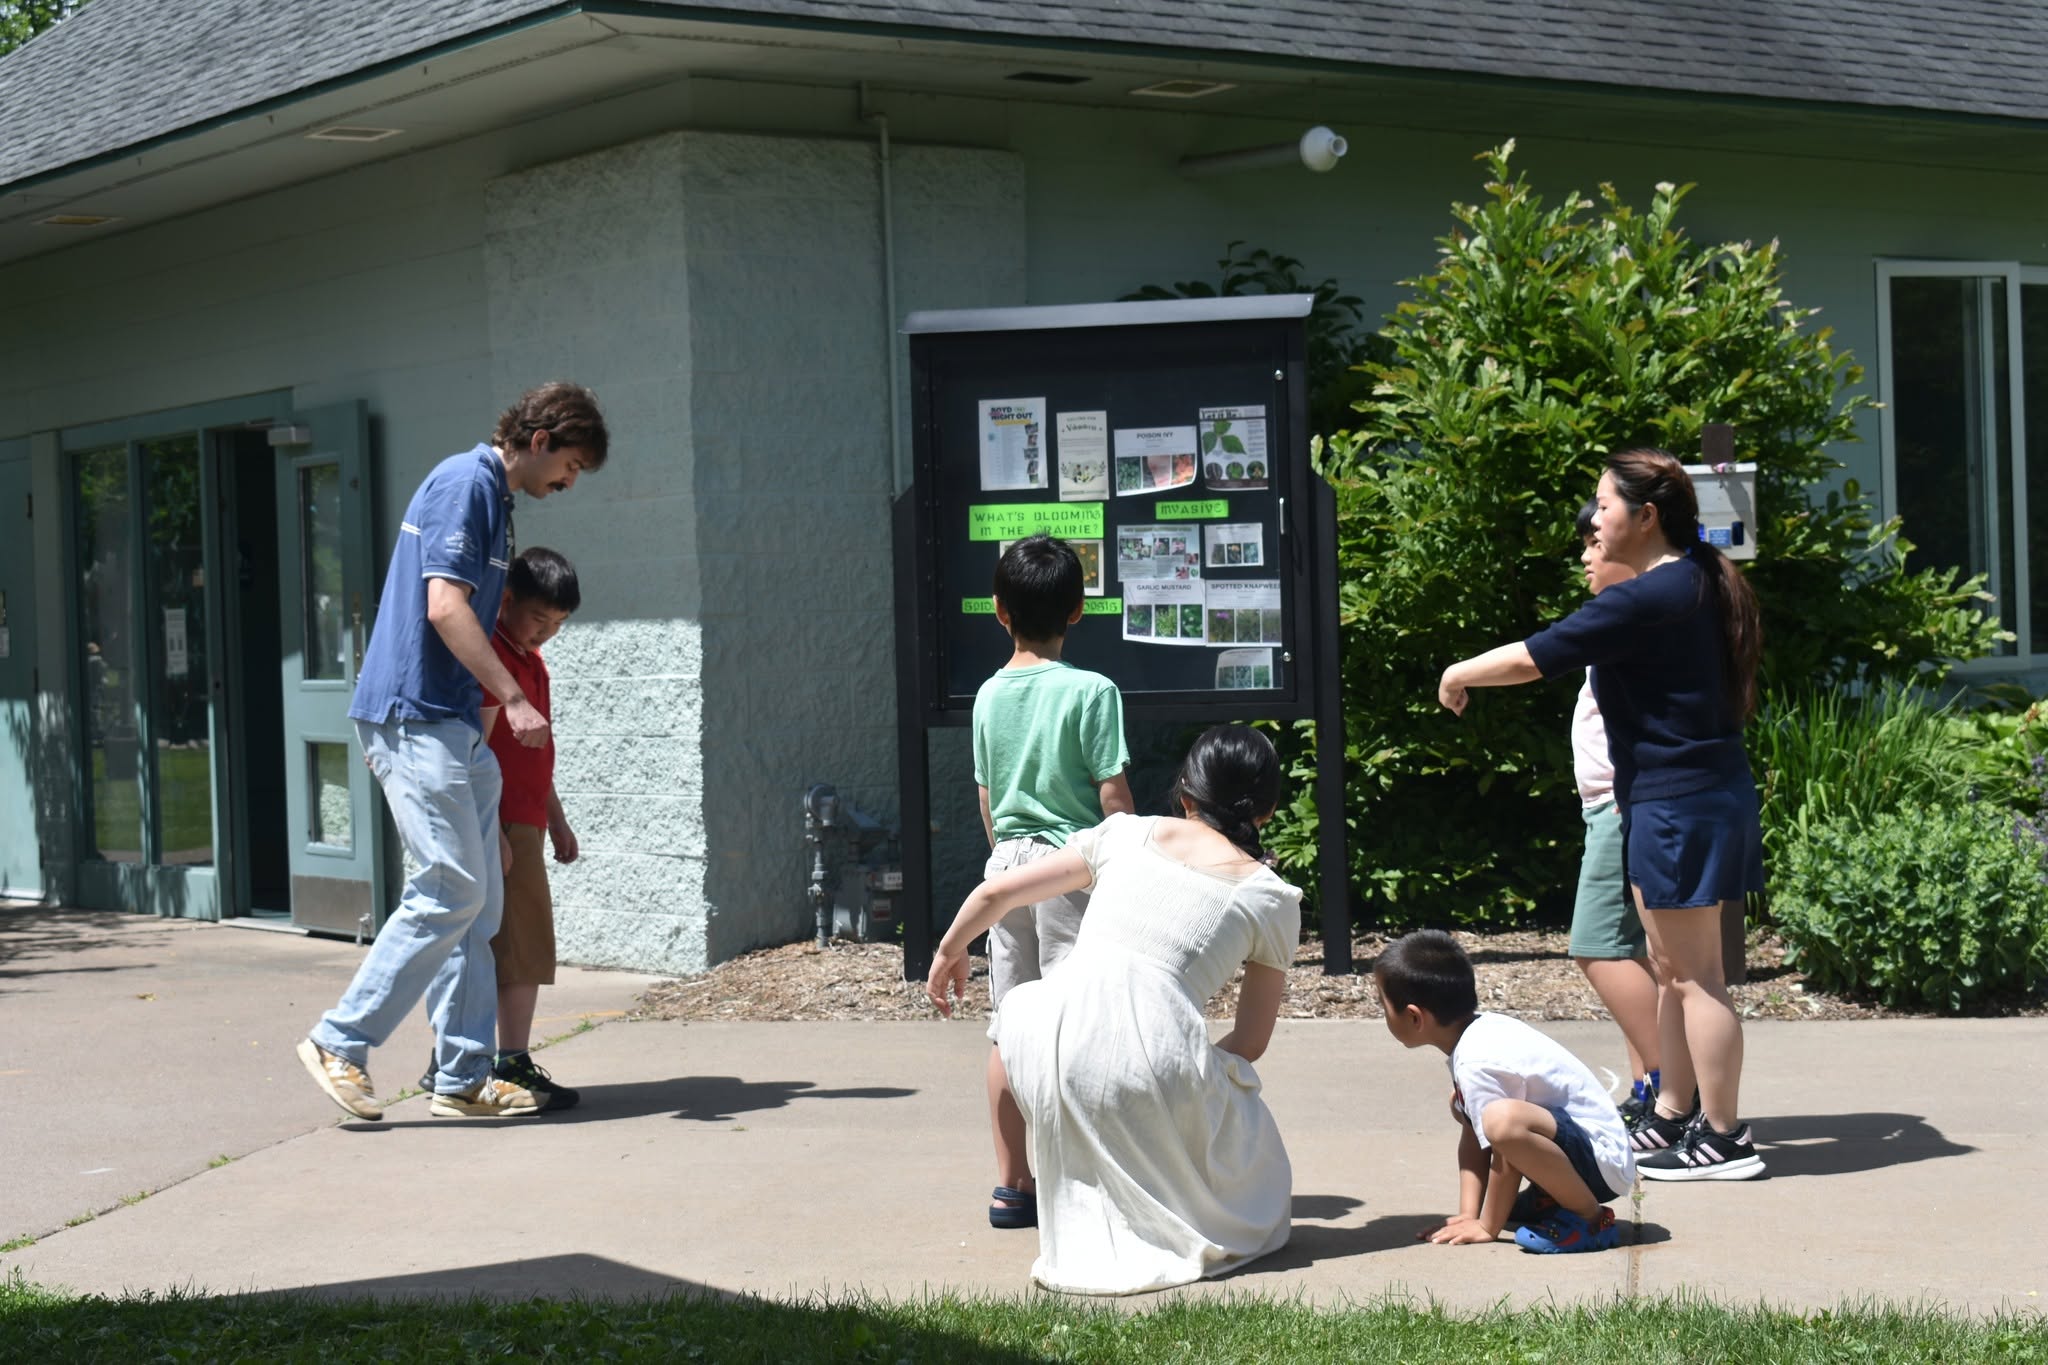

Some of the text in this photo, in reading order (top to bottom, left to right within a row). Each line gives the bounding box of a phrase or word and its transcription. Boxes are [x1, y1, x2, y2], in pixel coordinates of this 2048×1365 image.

[1160, 503, 1223, 515] INVASIVE
[974, 509, 1101, 522] WHAT'S BLOOMING
[980, 527, 992, 536] IN
[1001, 526, 1024, 536] THE
